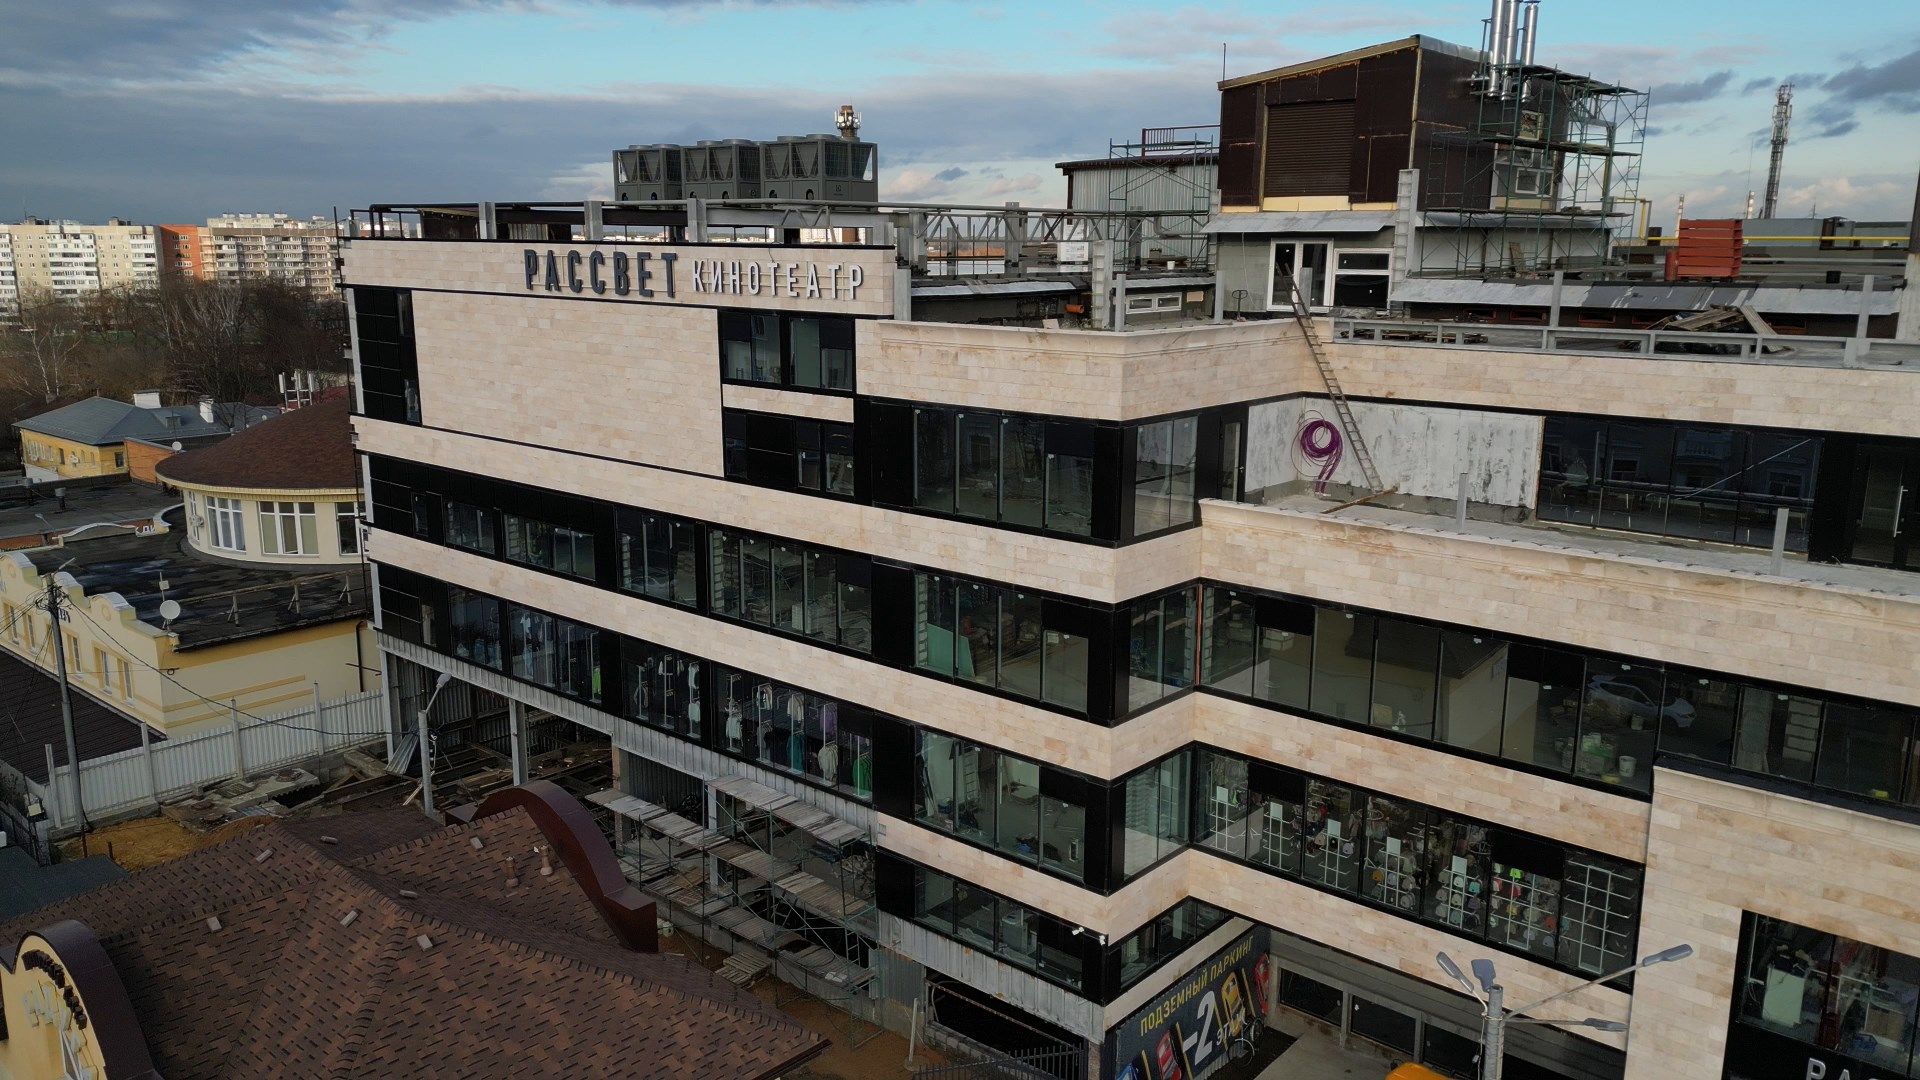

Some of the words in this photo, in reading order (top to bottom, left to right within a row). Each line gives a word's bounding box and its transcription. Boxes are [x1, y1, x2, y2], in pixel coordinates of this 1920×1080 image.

[523, 248, 677, 298] РАССВЕТ
[691, 259, 864, 300] КИНОТЕАТР
[1140, 968, 1208, 1037] ПОДЗЕМНЫЙ
[1210, 935, 1254, 982] ПАРКИНГ
[1183, 991, 1215, 1066] -2
